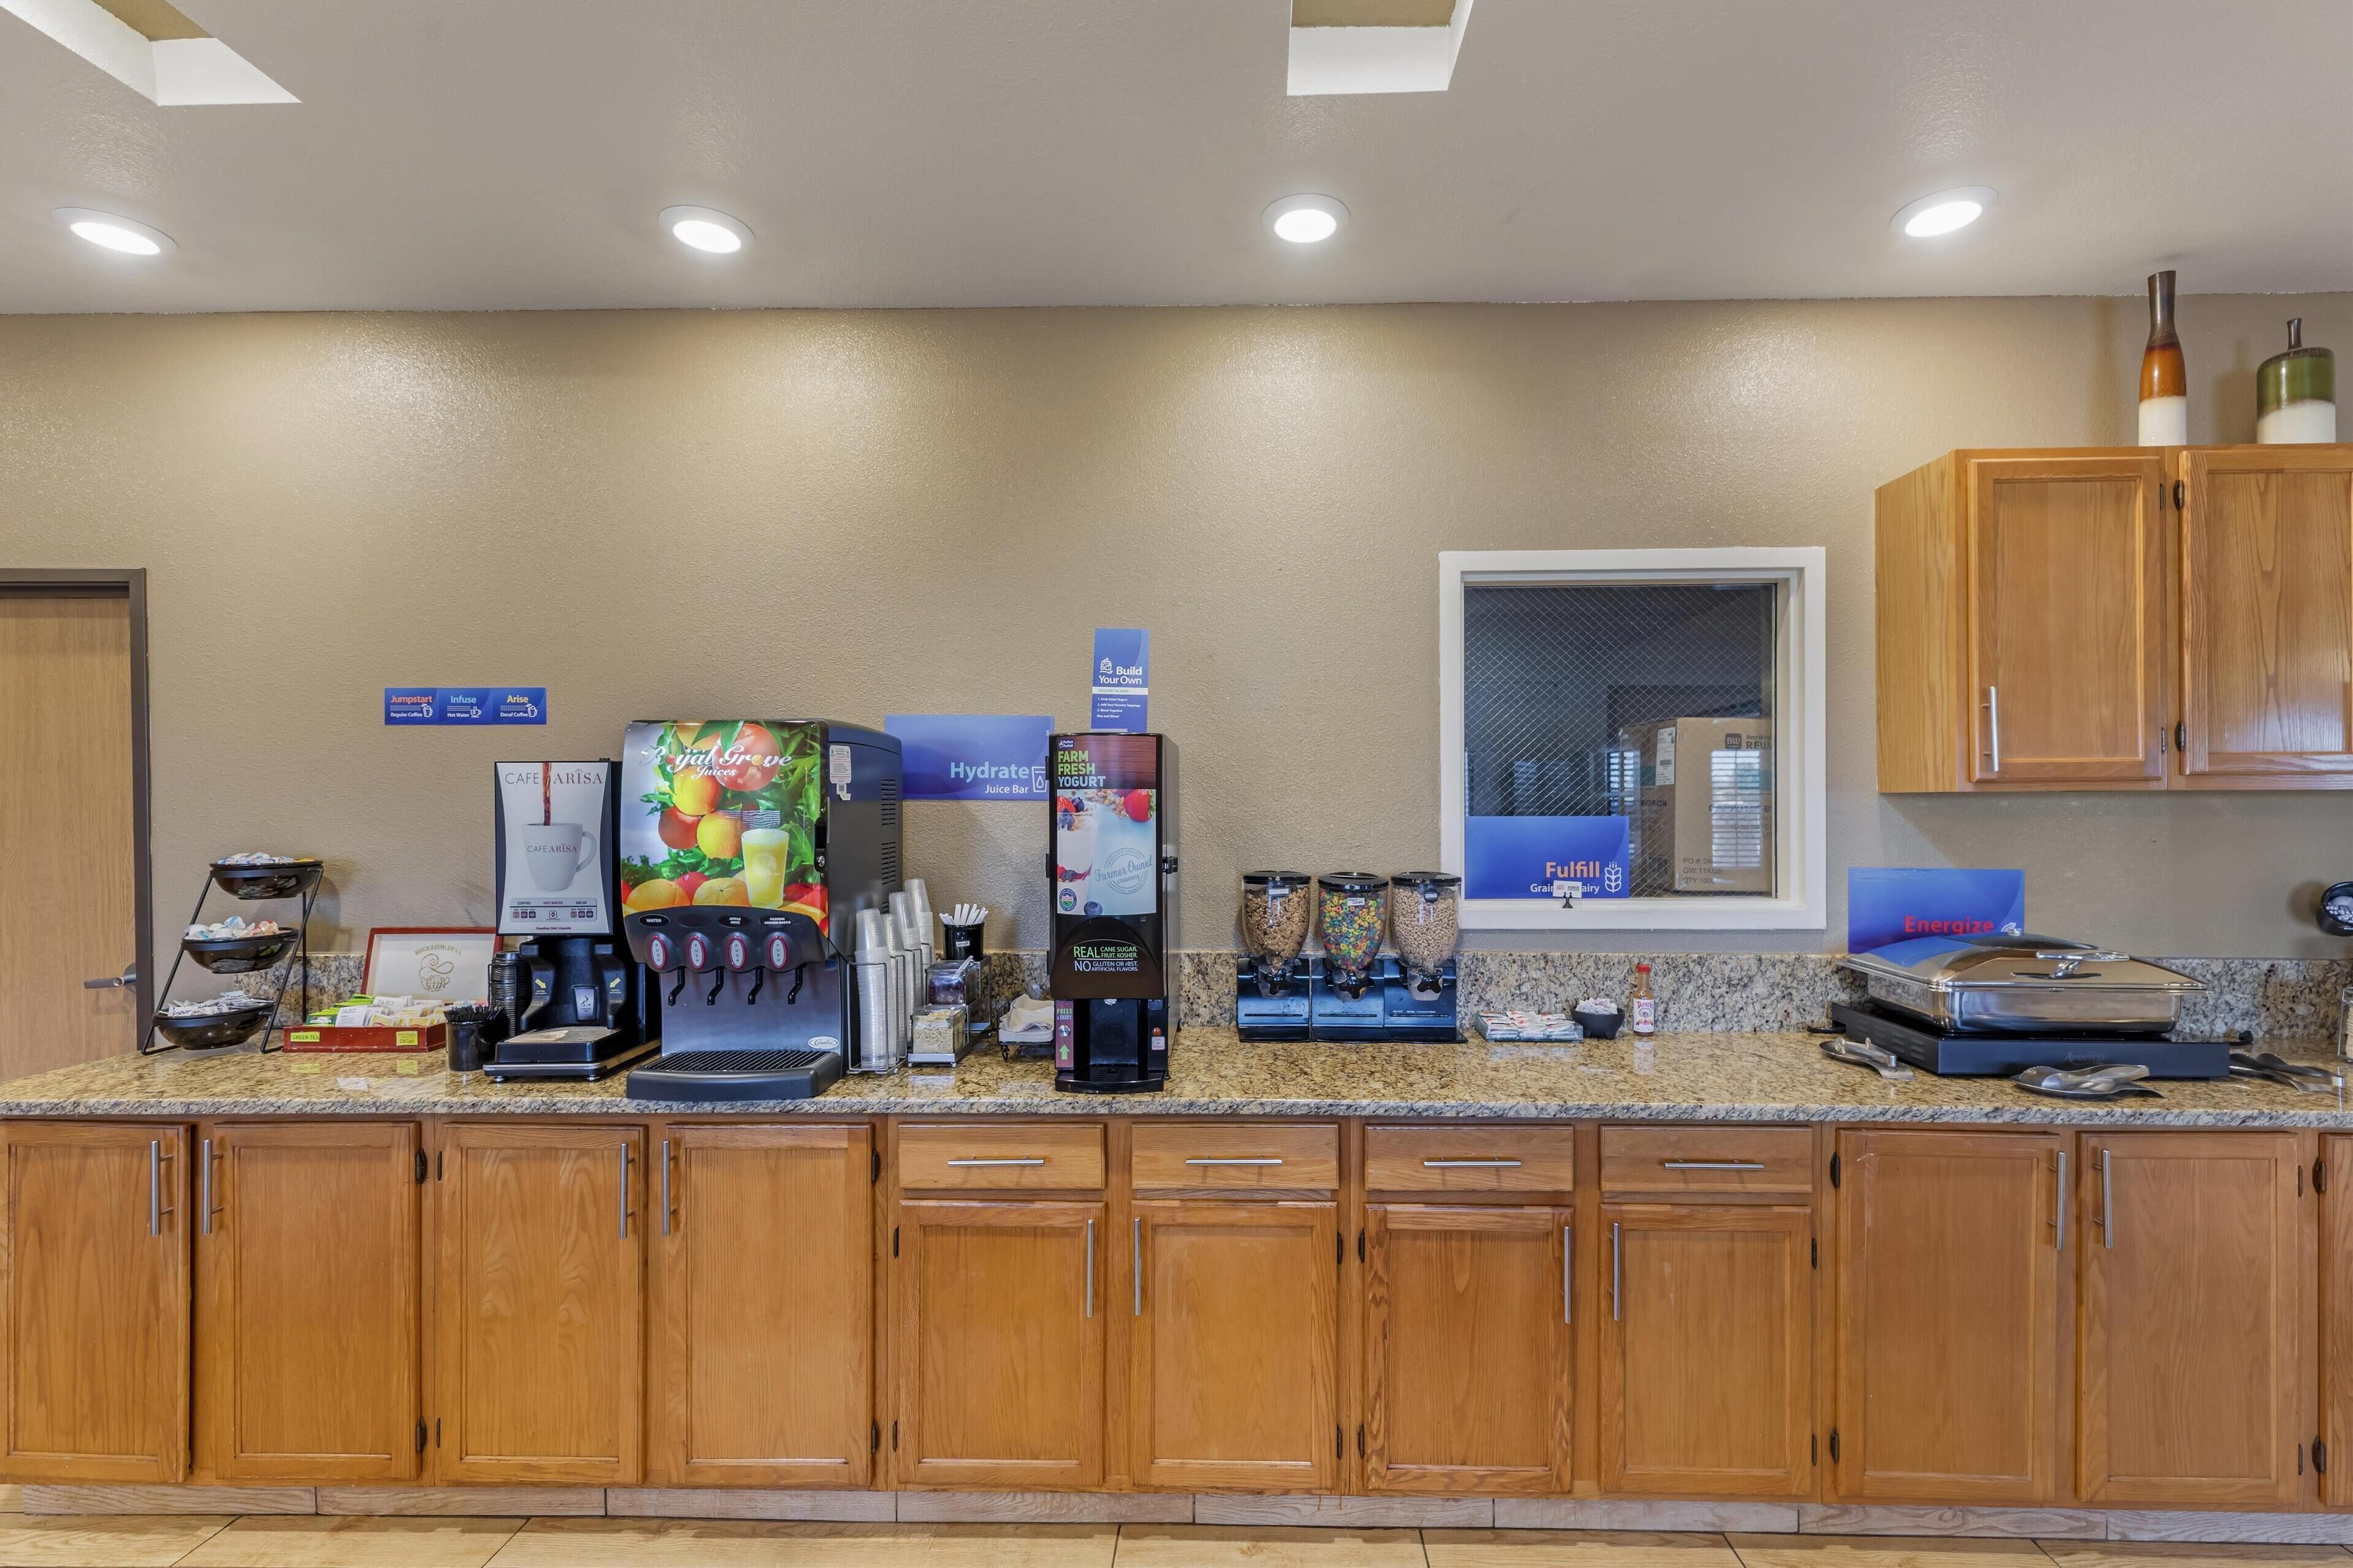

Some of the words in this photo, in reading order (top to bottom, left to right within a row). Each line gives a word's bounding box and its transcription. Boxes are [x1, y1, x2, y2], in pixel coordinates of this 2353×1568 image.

[1116, 666, 1142, 675] Build
[1099, 675, 1119, 684] Your
[1120, 676, 1142, 684] Own
[390, 695, 432, 705] Jumpstart
[507, 695, 529, 703] Arise
[1058, 751, 1089, 762] FARM
[691, 765, 737, 779] Juices
[951, 762, 1030, 783] Hydrate
[1058, 763, 1095, 775] FRESH
[505, 773, 540, 784] CAFE
[553, 772, 603, 784] ARISA
[1058, 776, 1106, 787] YOGURT
[985, 785, 1010, 794] Juice
[1012, 785, 1029, 794] Bar
[1094, 868, 1127, 882] Farmer
[1128, 854, 1153, 873] Owned
[1546, 861, 1600, 878] Fulfill
[1530, 884, 1554, 893] Grain
[1582, 883, 1600, 895] airy
[1904, 916, 1994, 935] Energize
[1074, 946, 1100, 958] REAL
[1074, 960, 1091, 971] NO
